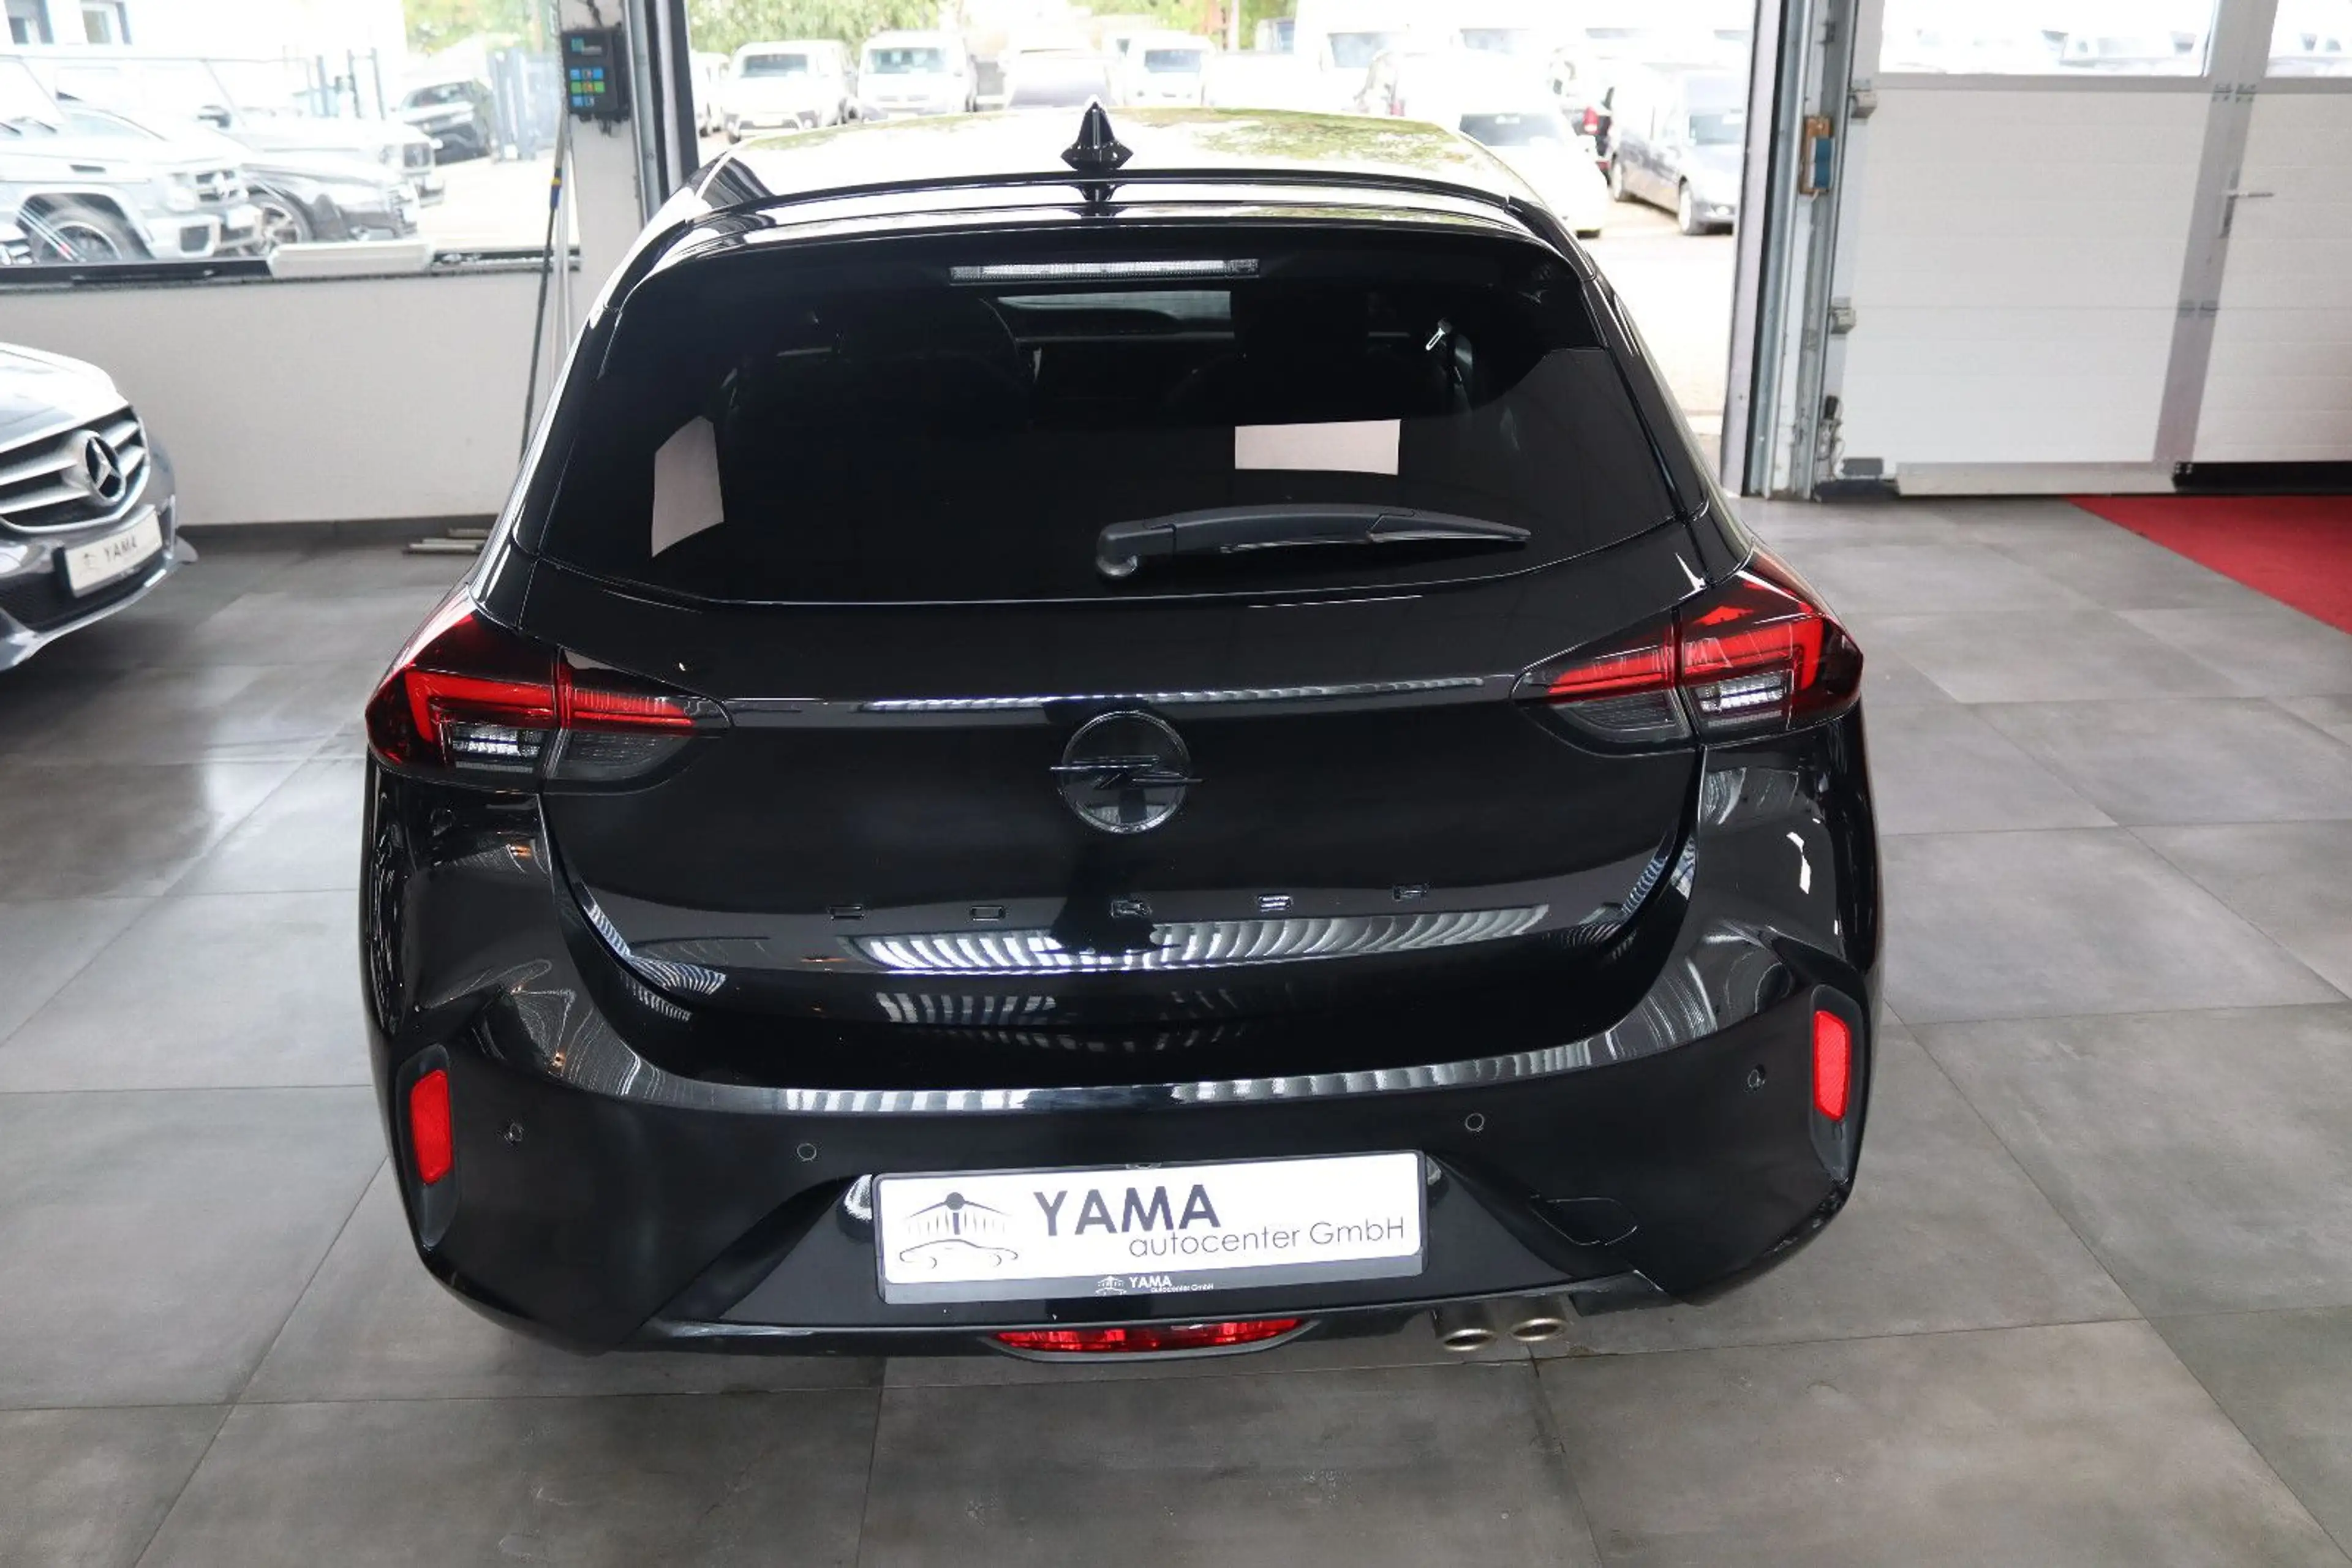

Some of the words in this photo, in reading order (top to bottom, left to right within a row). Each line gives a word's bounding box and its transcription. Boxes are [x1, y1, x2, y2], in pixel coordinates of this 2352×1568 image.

[1033, 1184, 1221, 1237] YAMA
[1129, 1226, 1300, 1257] autocenter
[1310, 1216, 1404, 1246] GmbH
[1129, 1275, 1172, 1288] YAMA
